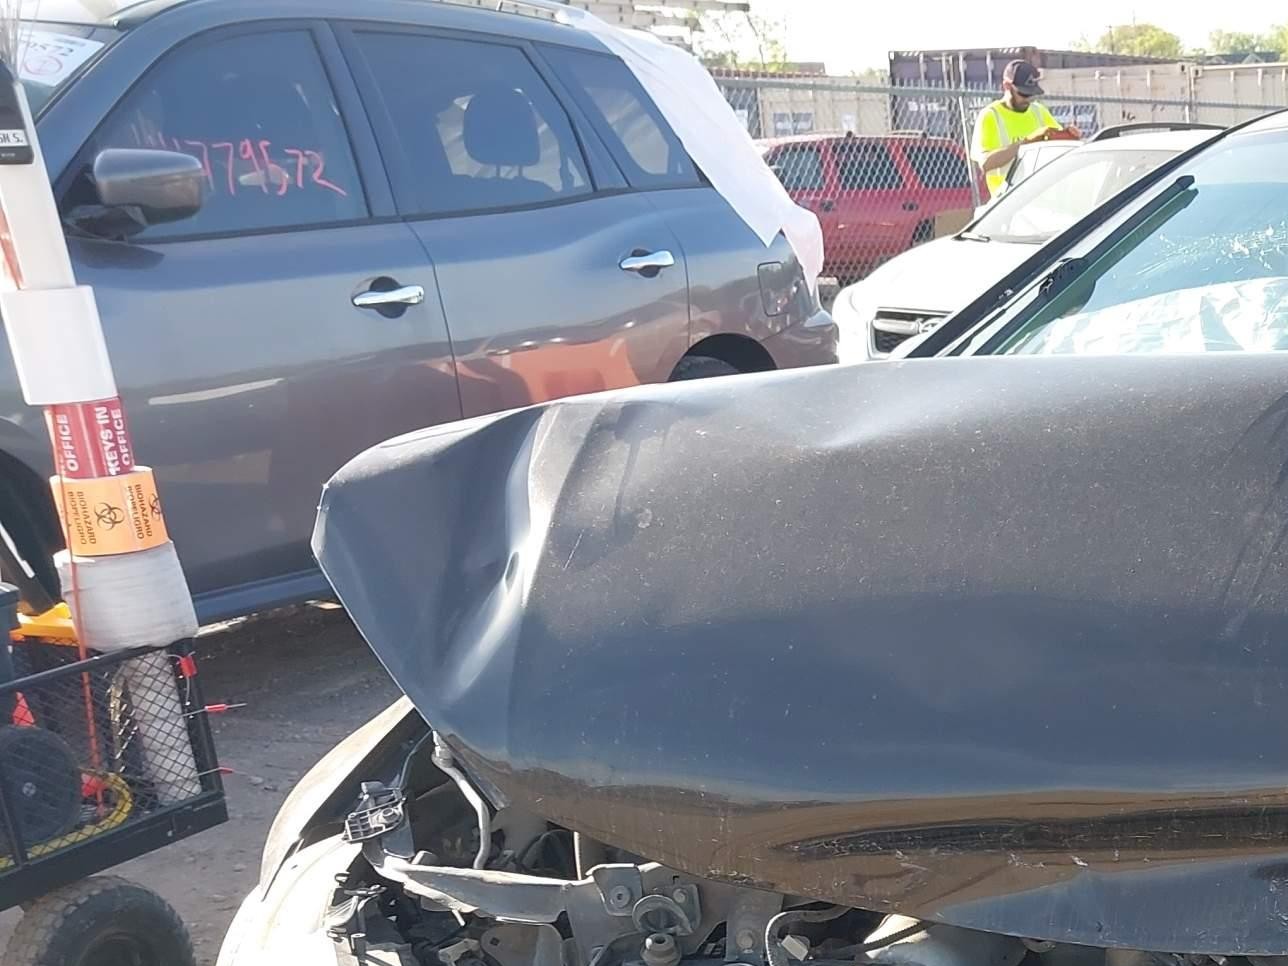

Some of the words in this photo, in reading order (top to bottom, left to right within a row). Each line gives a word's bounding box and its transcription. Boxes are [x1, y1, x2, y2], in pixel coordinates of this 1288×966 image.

[94, 406, 108, 425] IN
[111, 408, 131, 466] OFFICE
[56, 414, 79, 472] OFFICE
[100, 430, 121, 476] KEYS
[77, 491, 97, 545] BIOHAZARD
[134, 484, 153, 537] BIOHAZARD
